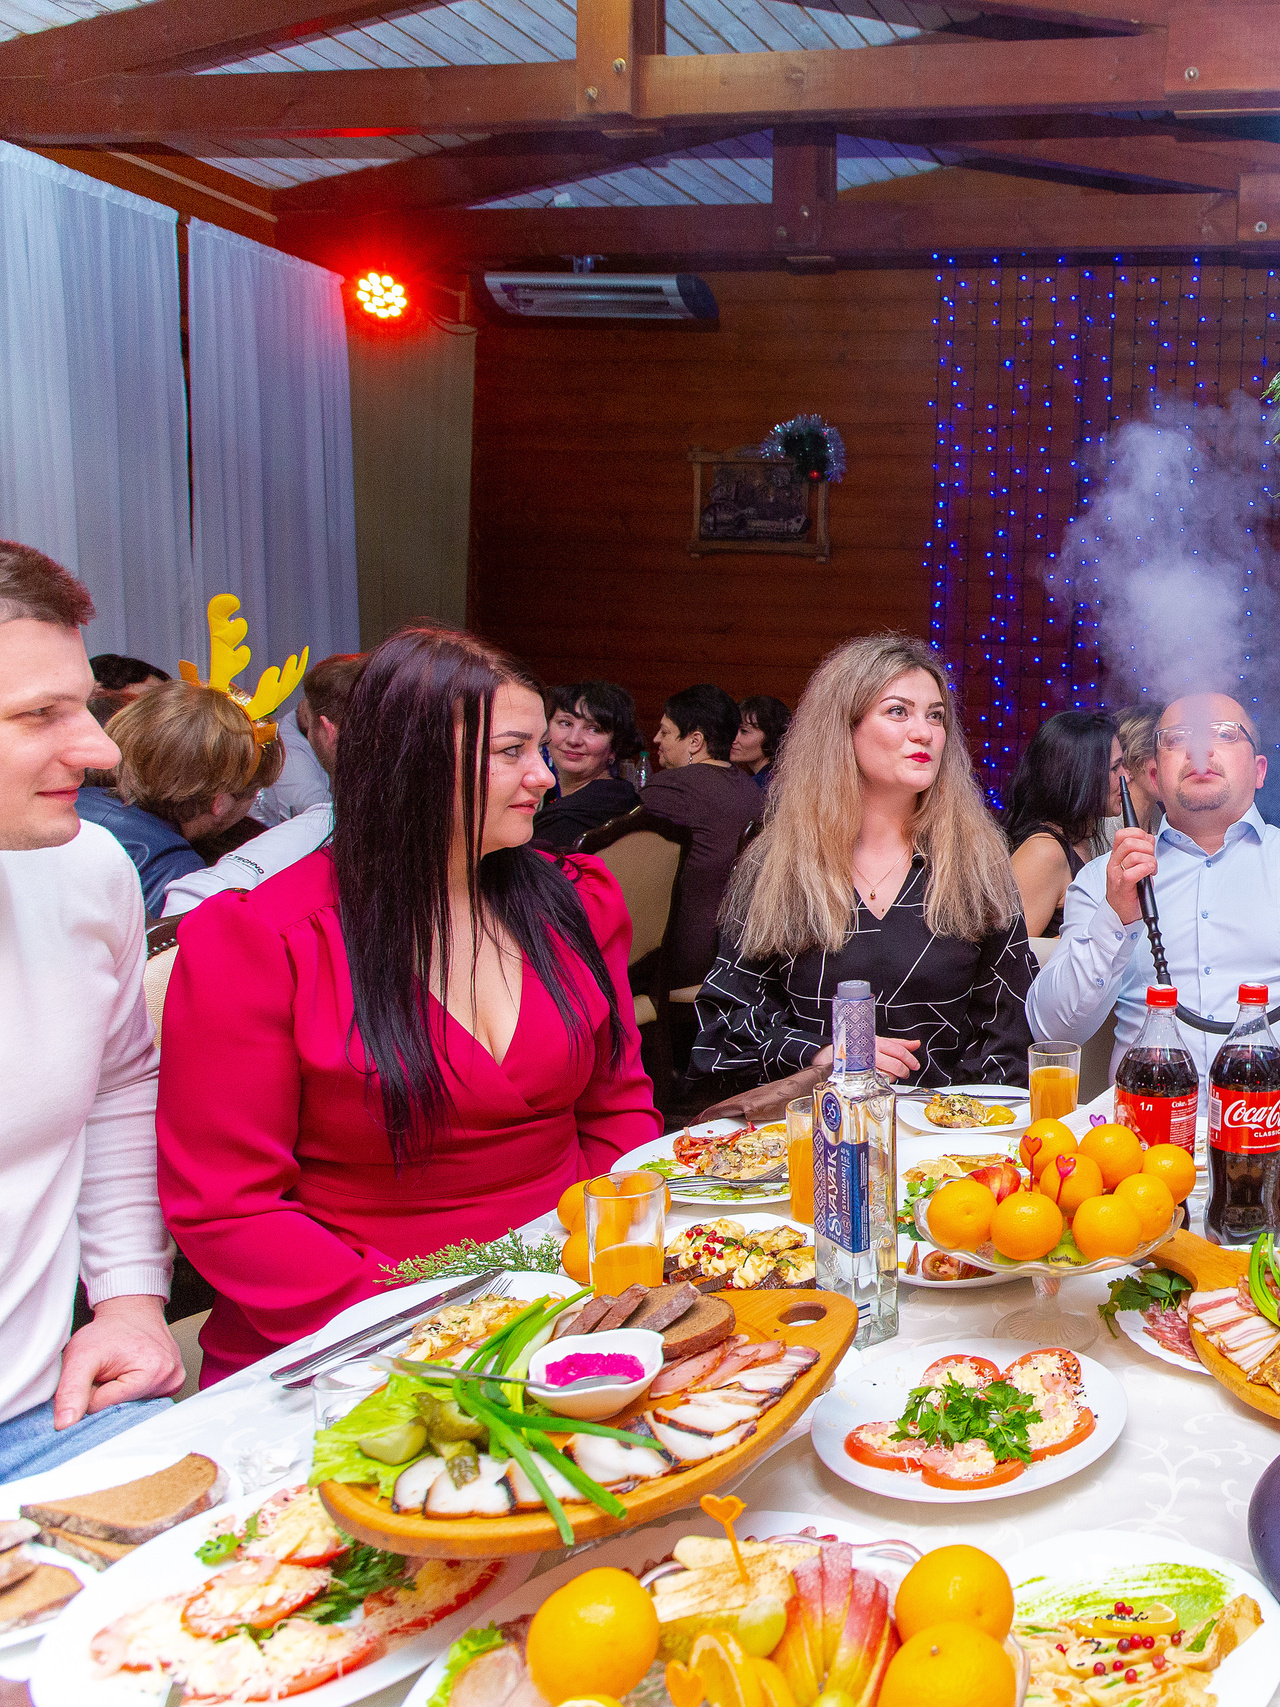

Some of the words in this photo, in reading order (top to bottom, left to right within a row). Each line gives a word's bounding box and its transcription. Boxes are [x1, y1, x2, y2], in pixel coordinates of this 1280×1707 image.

[235, 855, 265, 874] TECHNO
[1253, 1129, 1280, 1138] CLASSIC
[827, 1148, 842, 1237] SVAYAK
